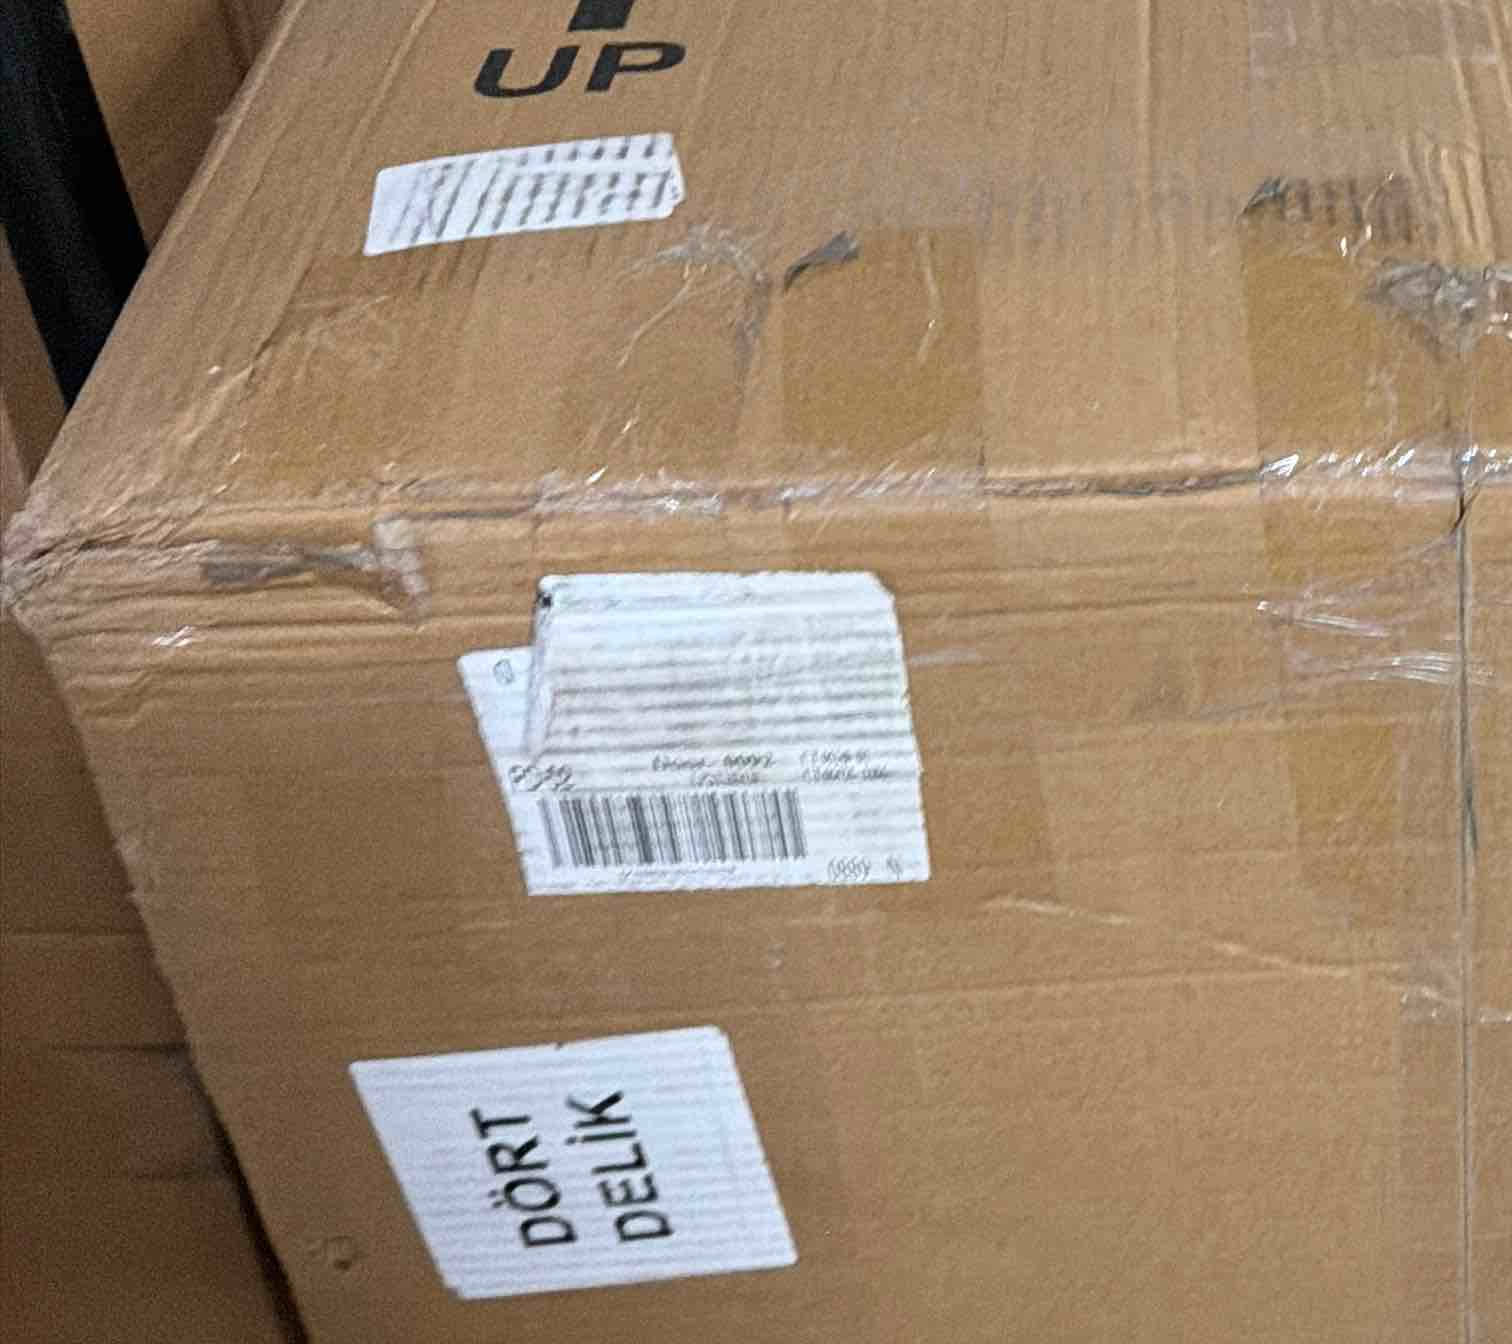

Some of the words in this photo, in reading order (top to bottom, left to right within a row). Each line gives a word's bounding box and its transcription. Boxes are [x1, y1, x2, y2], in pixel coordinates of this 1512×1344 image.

[474, 41, 686, 97] UP
[469, 1108, 578, 1248] DÖRT
[564, 1090, 673, 1243] DELİK
